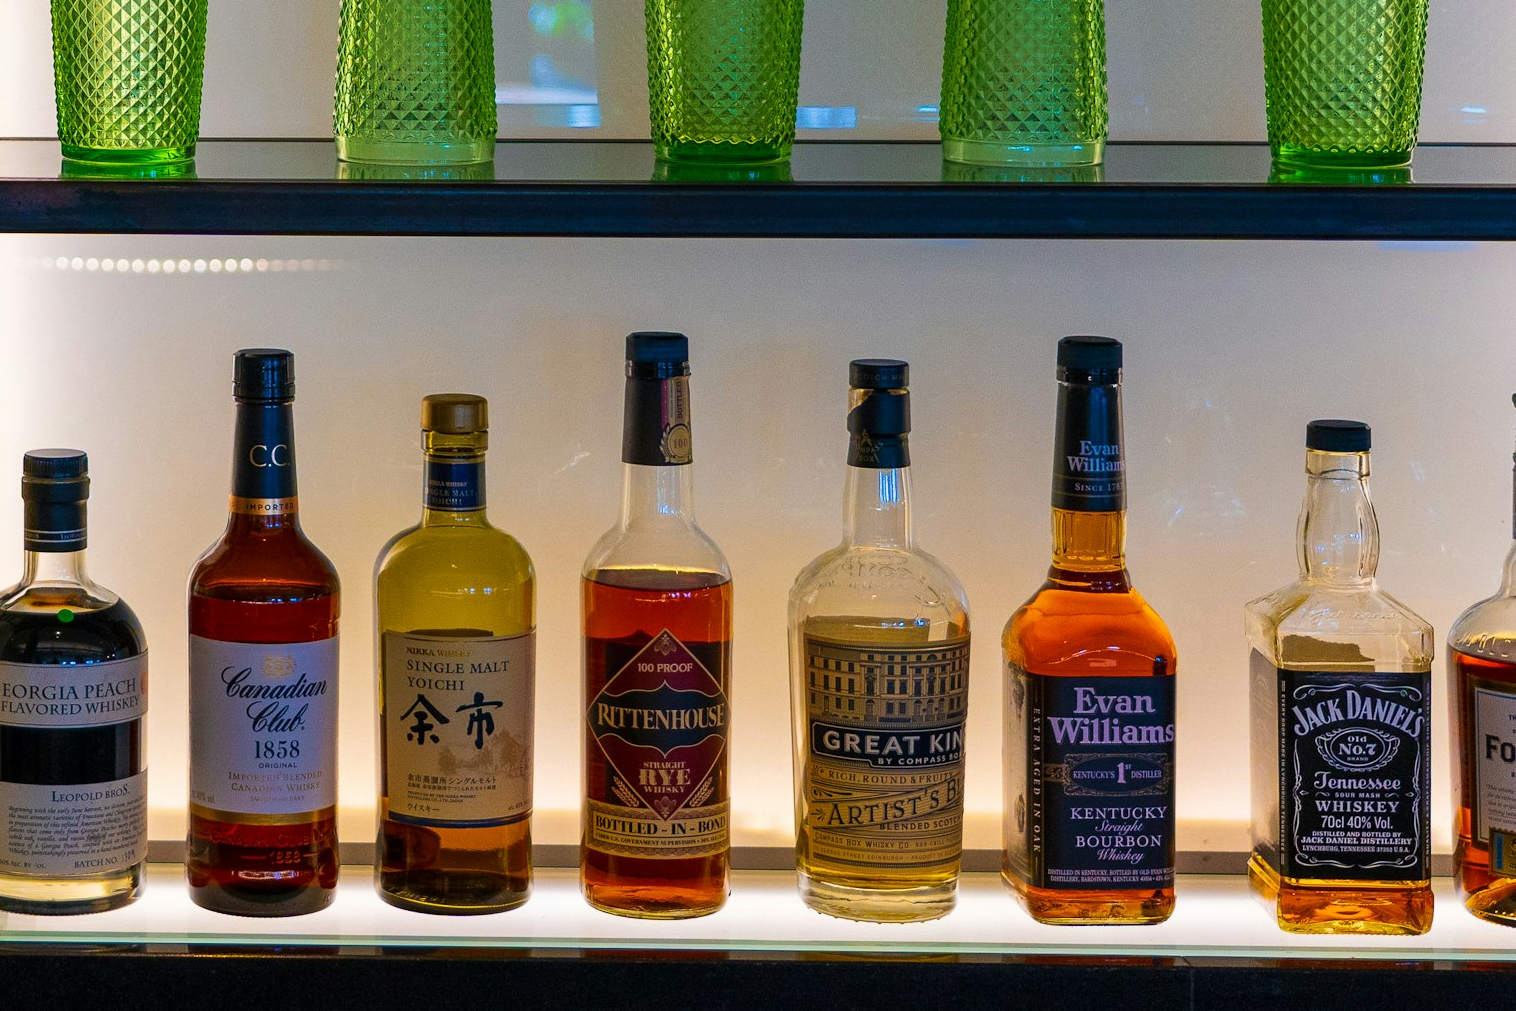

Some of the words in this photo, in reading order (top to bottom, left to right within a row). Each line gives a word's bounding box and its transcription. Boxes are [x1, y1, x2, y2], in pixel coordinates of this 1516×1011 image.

[1079, 440, 1119, 456] Evan
[1067, 456, 1125, 472] Williams
[406, 660, 464, 674] SINGLE
[469, 661, 509, 674] MALT
[638, 663, 656, 672] 100
[657, 663, 693, 672] PROOF
[84, 678, 136, 699] PEACH
[221, 665, 327, 699] Canadian
[407, 676, 465, 690] YOICHI
[1, 701, 82, 716] FLAVORED
[85, 695, 139, 714] WHISKEY
[1073, 687, 1156, 714] Evan
[400, 692, 504, 749] 余市
[597, 703, 725, 730] RITTENHOUSE
[1291, 697, 1344, 736] JACK
[1346, 690, 1424, 738] DANIEL'S
[1033, 708, 1041, 751] EXTRA
[1047, 716, 1174, 745] Williams
[823, 730, 920, 756] GREAT
[929, 735, 963, 754] KIN
[1347, 735, 1367, 743] Old
[254, 740, 300, 759] 1858
[1338, 743, 1376, 755] No.7
[878, 757, 893, 765] BY
[898, 755, 946, 766] COMPASS
[949, 753, 963, 761] BO
[228, 771, 281, 781] IMPORTED
[284, 770, 322, 781] BLENDED
[639, 769, 691, 785] RYE
[1033, 759, 1041, 795] AGED
[1313, 771, 1401, 790] Tennessee
[231, 782, 284, 792] CANADIAN
[287, 781, 319, 792] WHISKY
[407, 803, 439, 812] ウイスキー
[828, 788, 938, 825] ARTIST'S
[1033, 802, 1041, 817] IN
[1070, 806, 1168, 820] KENTUCKY
[1315, 800, 1399, 813] WHISKEY
[596, 815, 658, 835] BOTTLED
[672, 821, 686, 835] IN
[698, 816, 726, 831] BOND
[1095, 820, 1143, 835] Straight
[1321, 816, 1344, 829] 70cl
[1347, 816, 1371, 829] 40%
[1373, 816, 1393, 829] Vol.
[1033, 825, 1041, 853] OAK
[1076, 835, 1162, 848] BOURBON
[1360, 837, 1412, 845] DISTILLERY
[74, 859, 103, 868] BATCH
[1097, 848, 1144, 865] Whiskey
